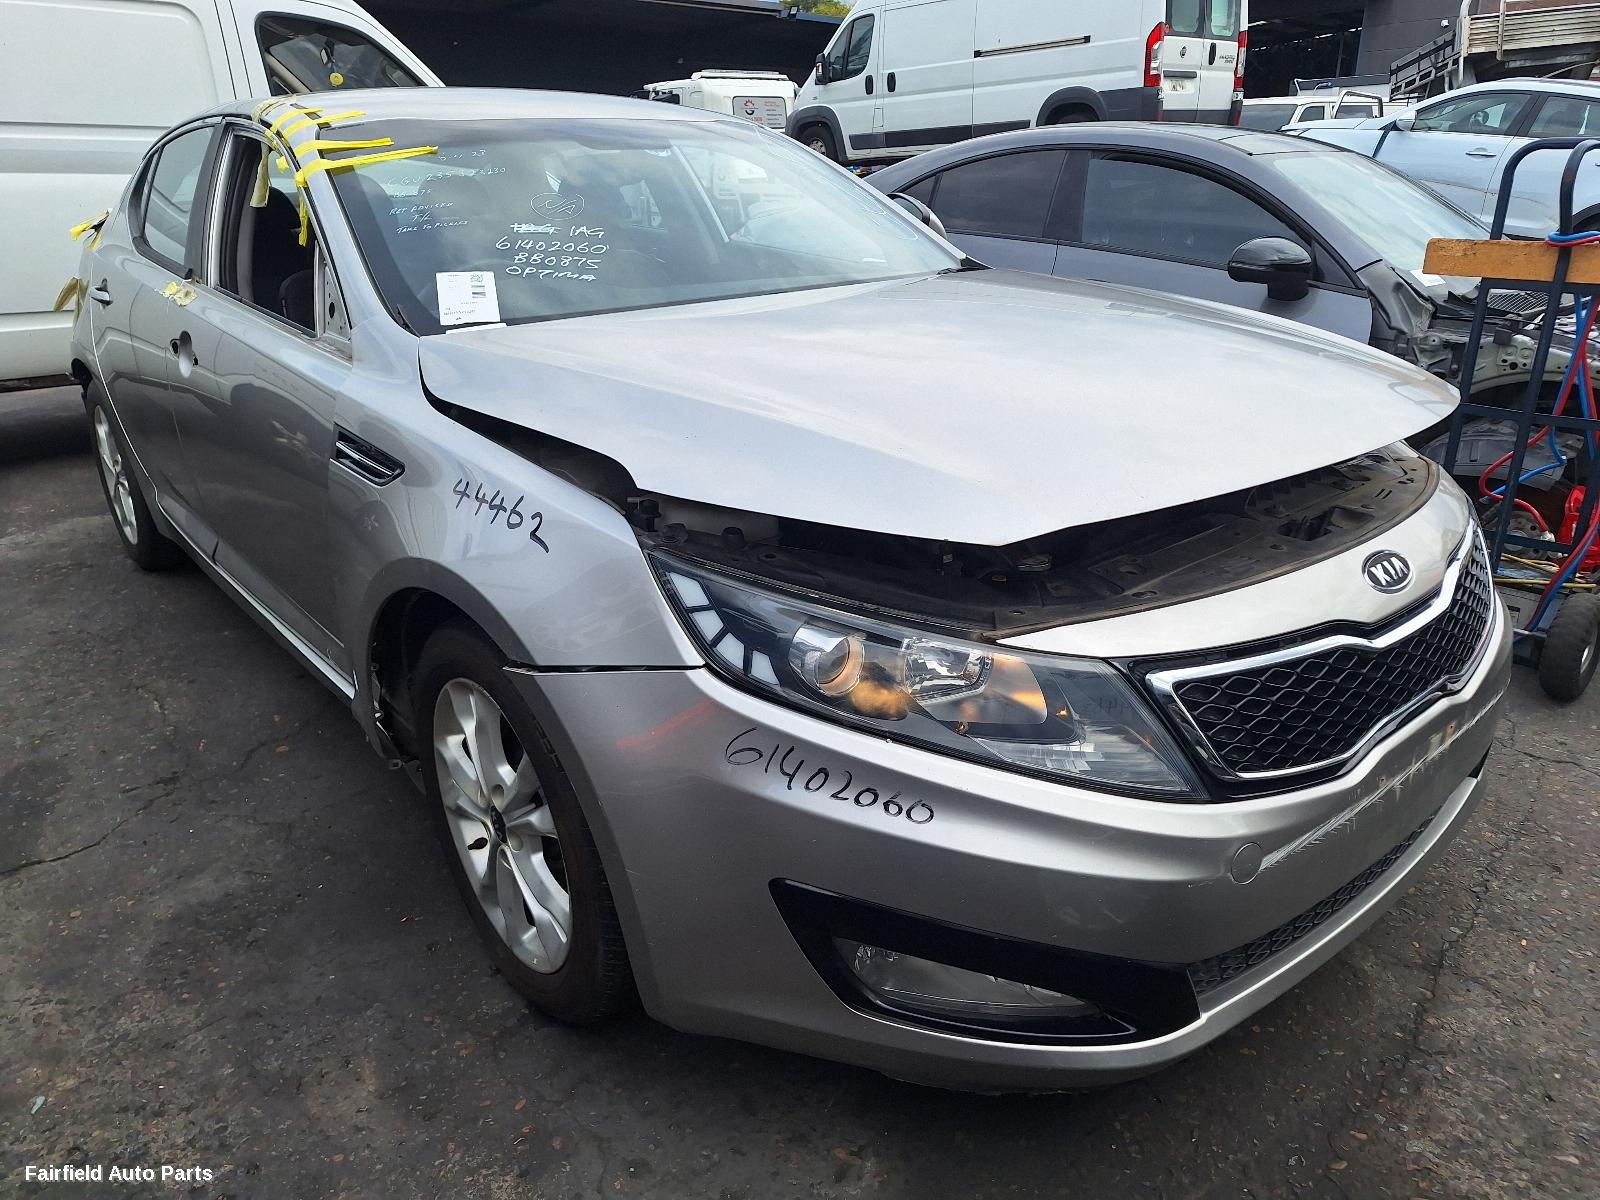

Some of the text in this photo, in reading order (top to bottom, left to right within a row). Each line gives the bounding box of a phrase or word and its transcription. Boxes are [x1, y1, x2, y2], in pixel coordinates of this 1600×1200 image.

[495, 236, 608, 255] 61402060
[453, 478, 550, 554] 44462
[1370, 556, 1409, 586] KIA
[725, 727, 935, 824] 61402060
